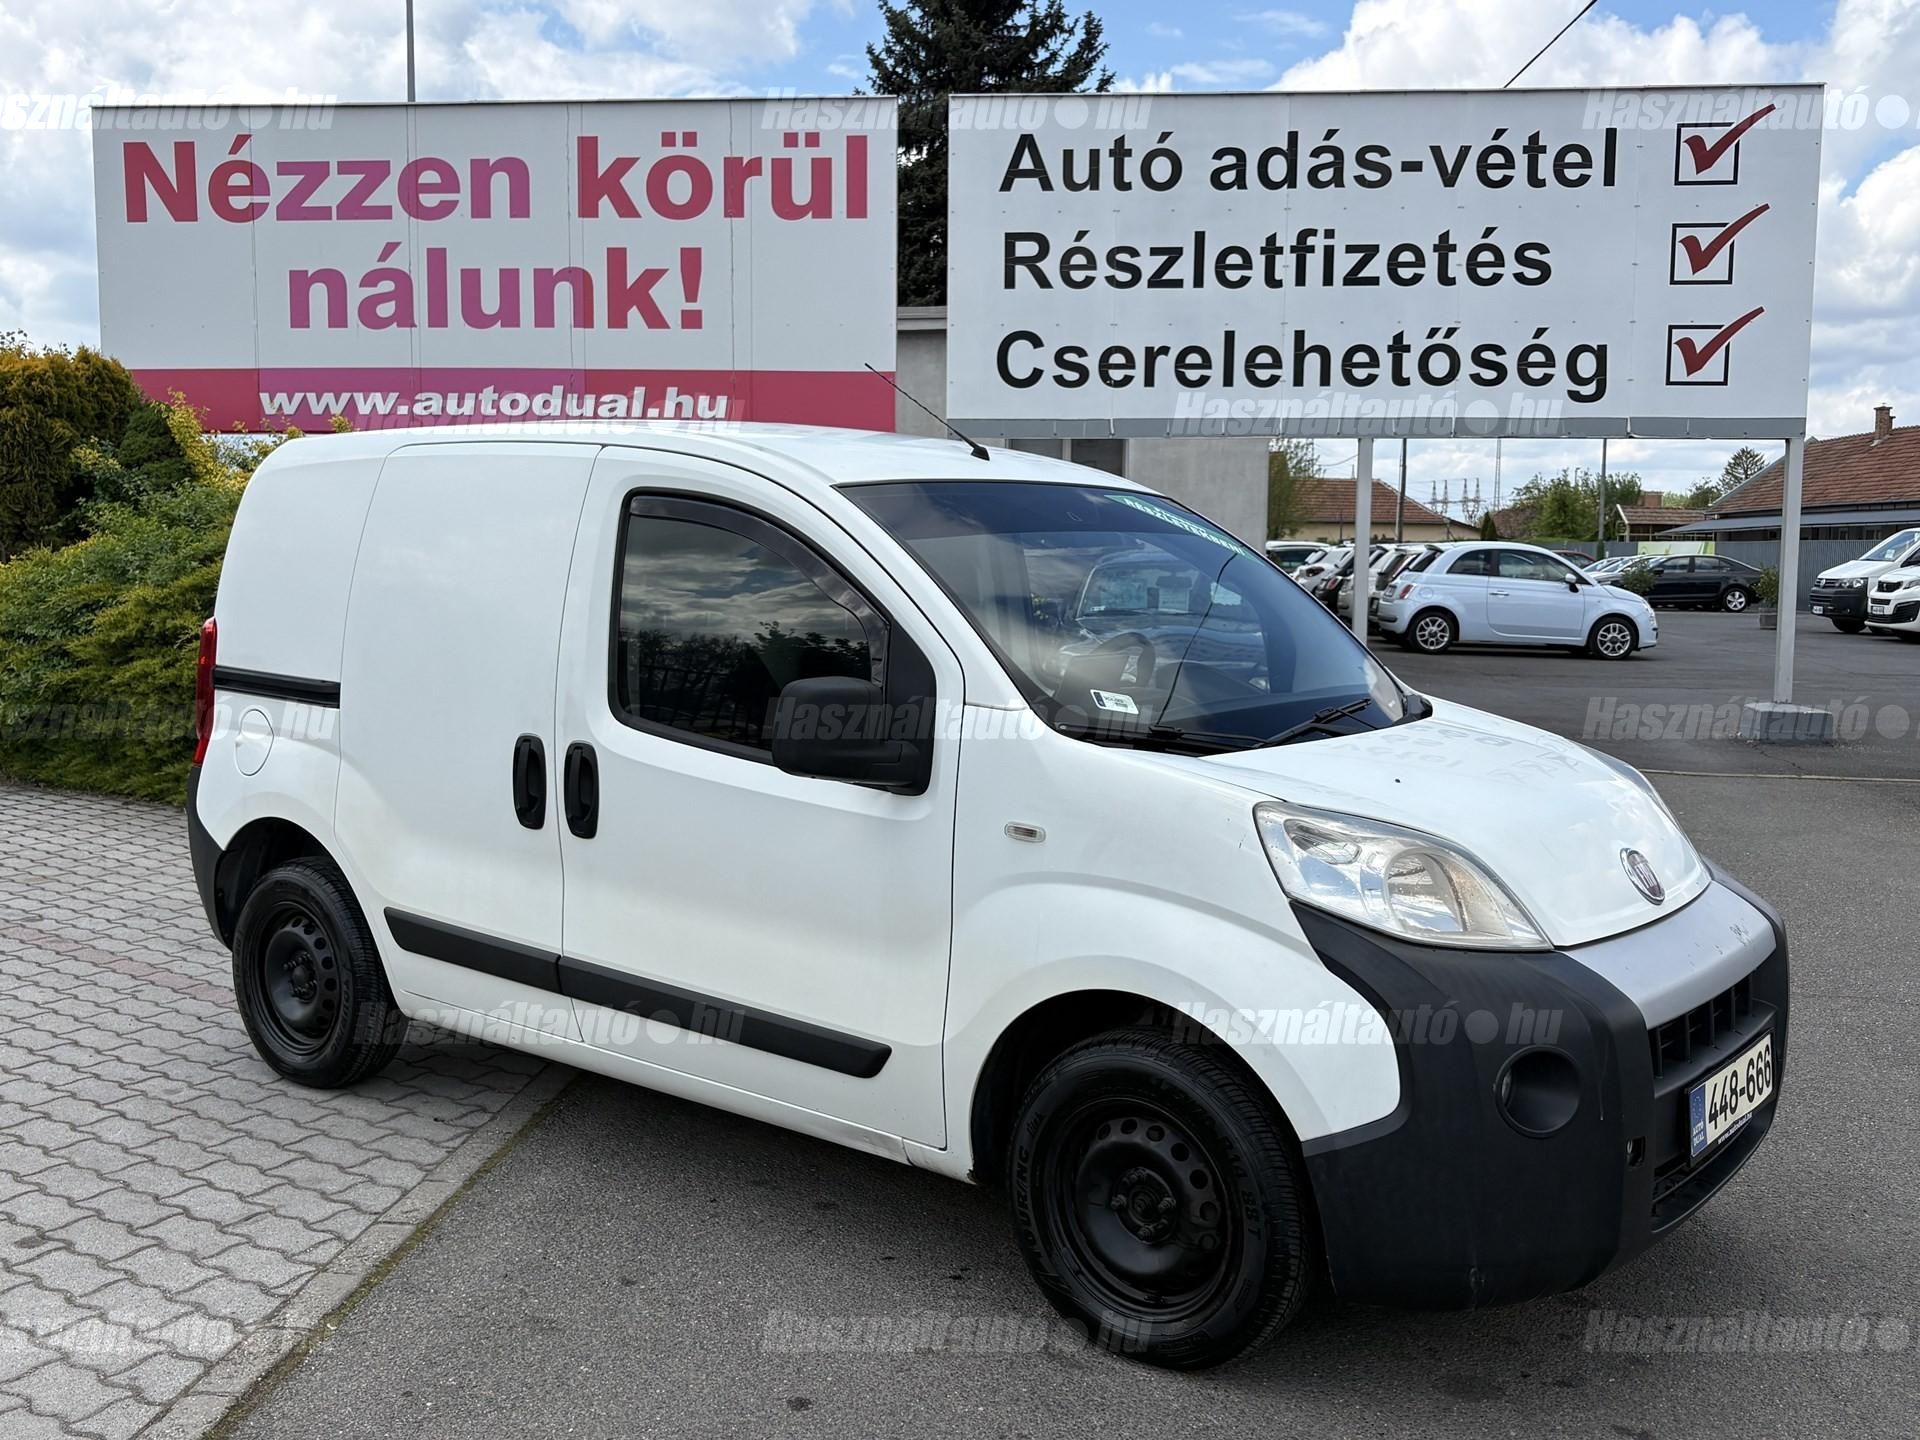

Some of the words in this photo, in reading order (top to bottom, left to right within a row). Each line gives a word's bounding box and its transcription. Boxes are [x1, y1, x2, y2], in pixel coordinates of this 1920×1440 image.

[124, 134, 530, 222] Nézzen
[578, 132, 868, 220] körül
[998, 131, 1184, 193] Autó
[1208, 127, 1618, 191] adás-vétel
[290, 242, 702, 330] nálunk!
[1003, 226, 1552, 290] Részletfizetés
[259, 385, 728, 420] www.autodual.hu
[996, 326, 1608, 403] Cserelehetőség
[1708, 1043, 1771, 1130] 448-666
